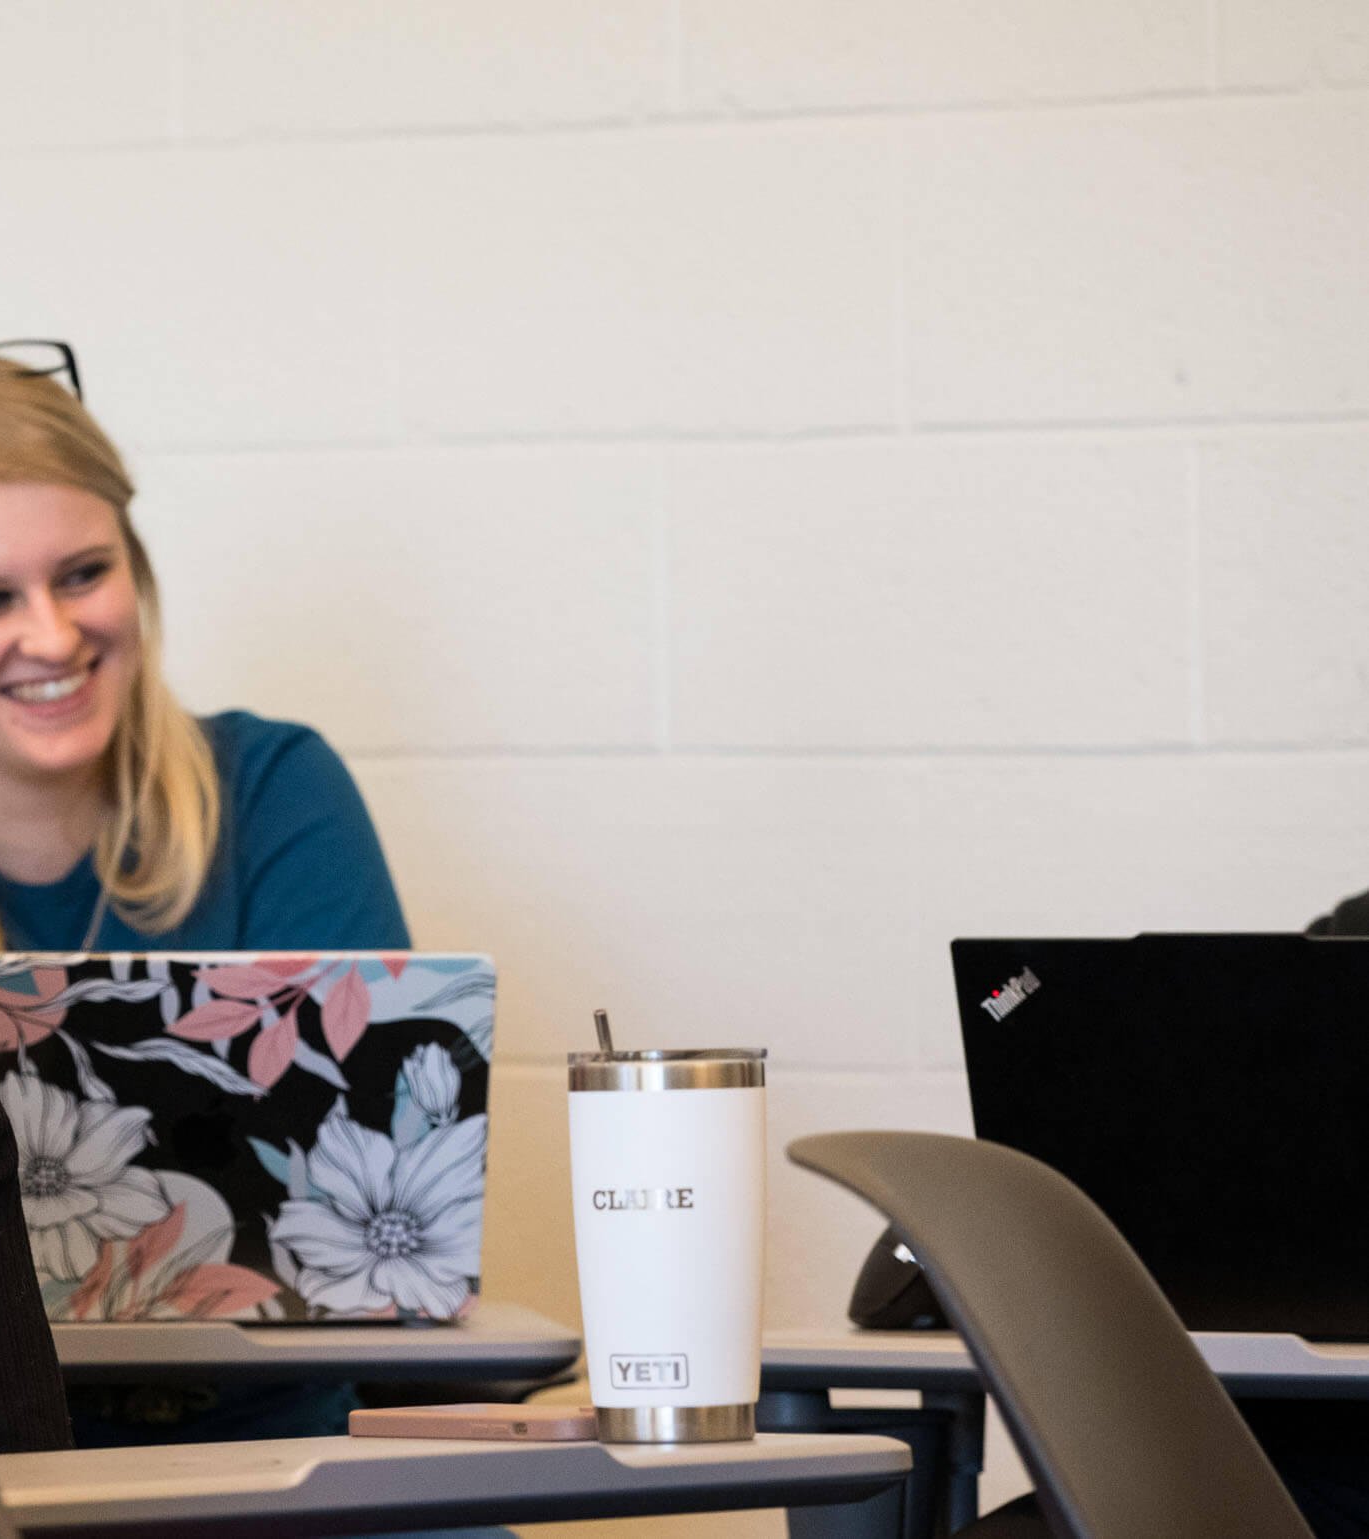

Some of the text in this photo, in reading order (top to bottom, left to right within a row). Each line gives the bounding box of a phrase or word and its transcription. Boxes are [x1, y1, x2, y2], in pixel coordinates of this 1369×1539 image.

[980, 966, 1041, 1022] ThinkPad
[593, 1188, 693, 1210] CLAIRE
[616, 1361, 680, 1382] YETI
